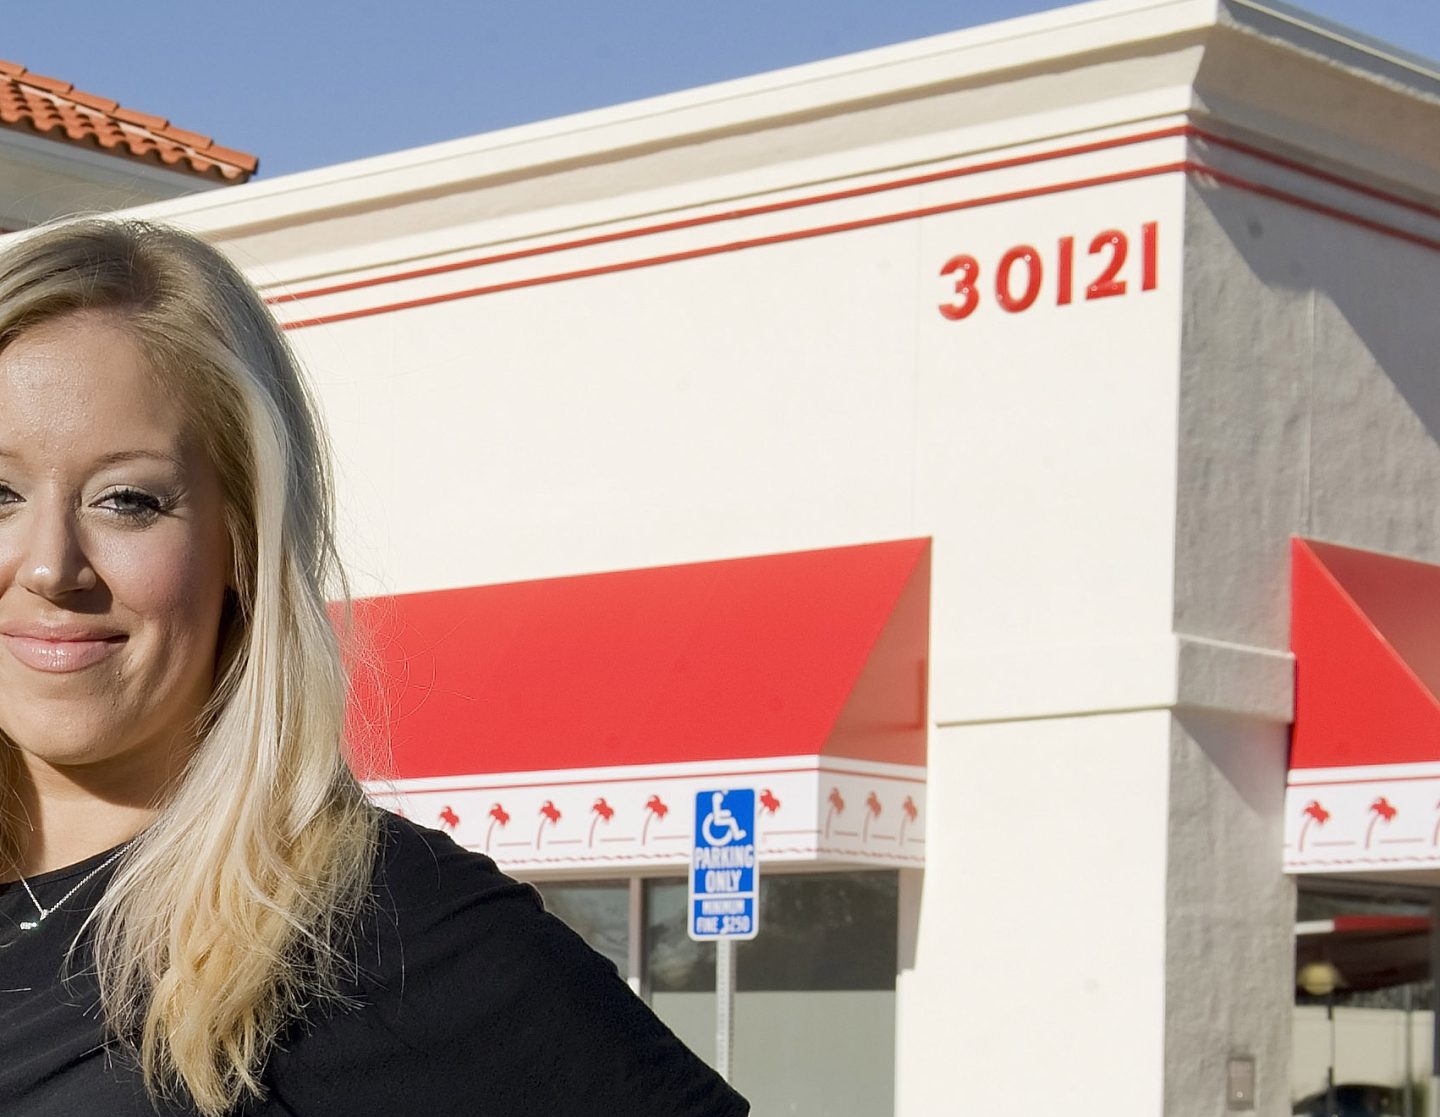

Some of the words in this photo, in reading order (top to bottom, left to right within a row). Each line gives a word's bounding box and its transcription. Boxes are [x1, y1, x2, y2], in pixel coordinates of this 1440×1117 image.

[937, 220, 1158, 322] 30121
[694, 845, 755, 870] PARKING
[704, 870, 742, 893] ONLY
